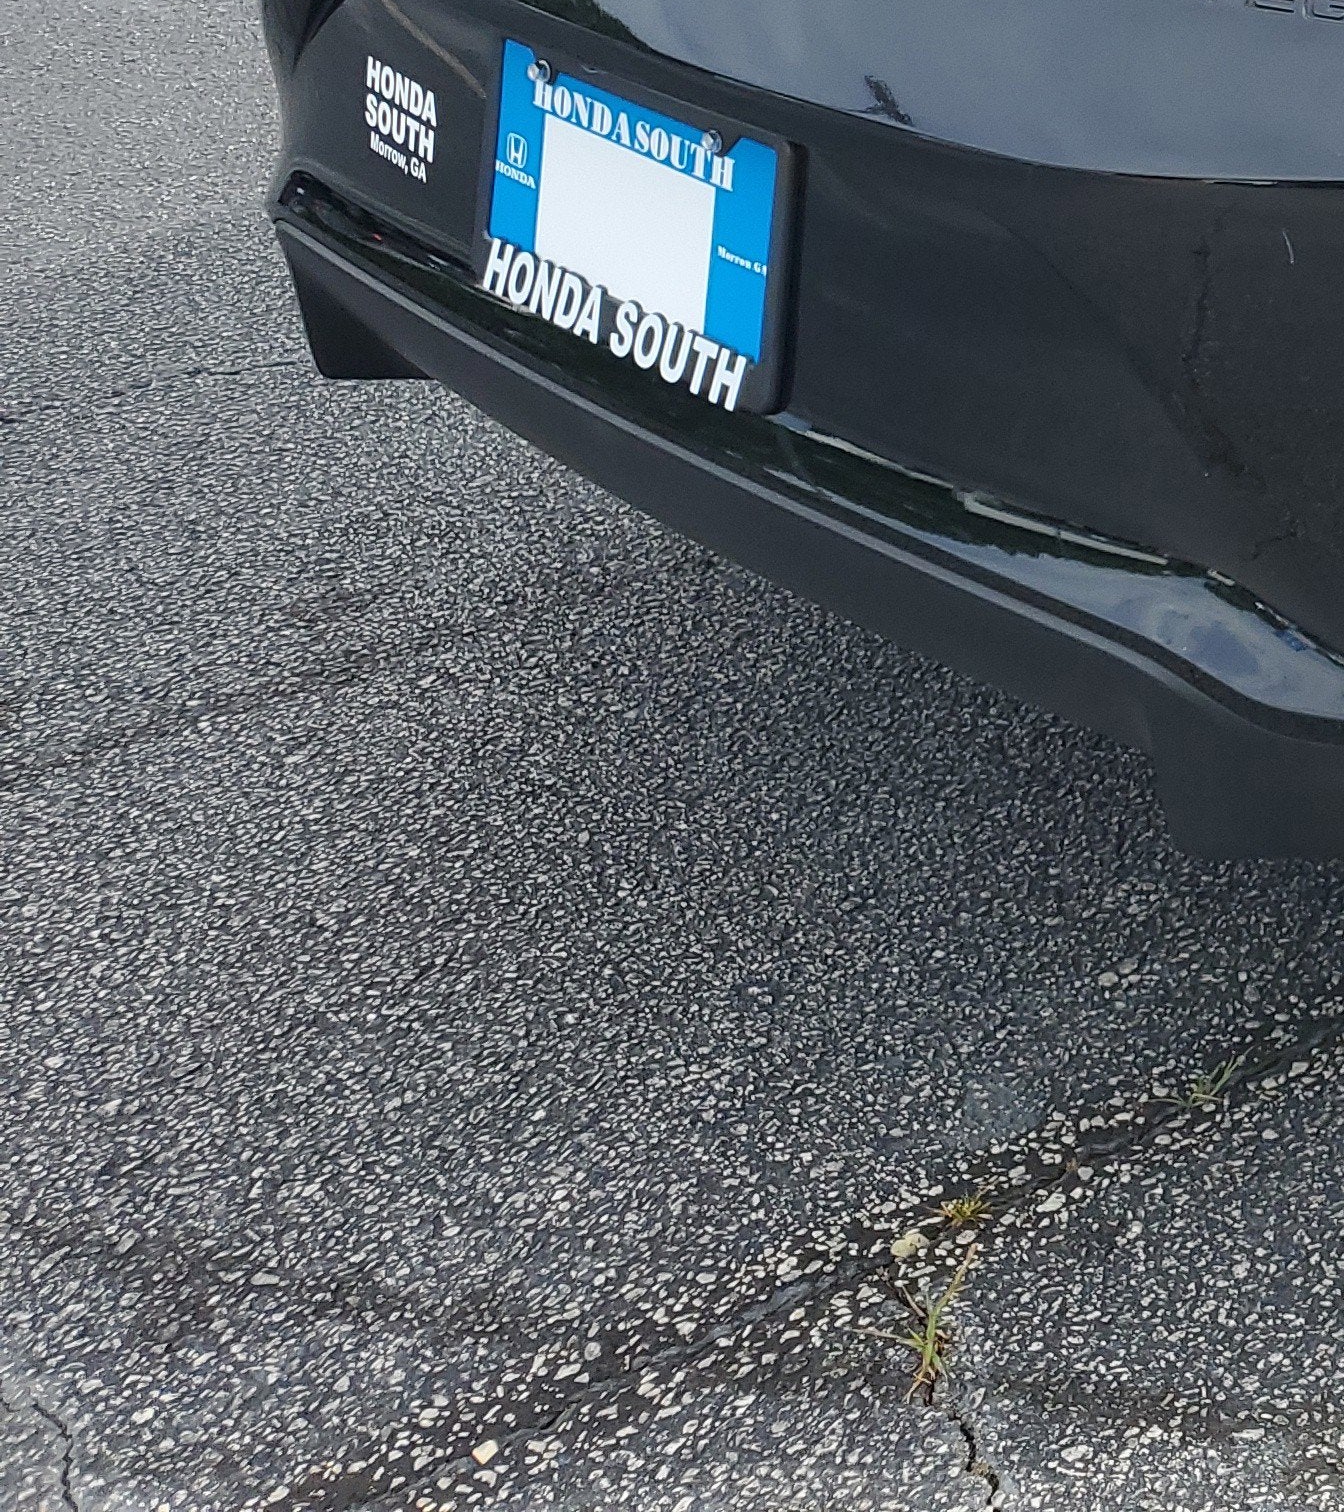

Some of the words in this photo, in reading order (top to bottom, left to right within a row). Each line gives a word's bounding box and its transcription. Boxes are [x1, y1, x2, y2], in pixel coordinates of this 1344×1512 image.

[366, 55, 437, 128] HONDA
[364, 93, 435, 164] SOUTH
[370, 130, 409, 175] Morrow,
[409, 156, 427, 184] GA
[495, 159, 536, 189] HONDA
[482, 237, 602, 345] HONDA
[609, 299, 748, 413] SOUTH
